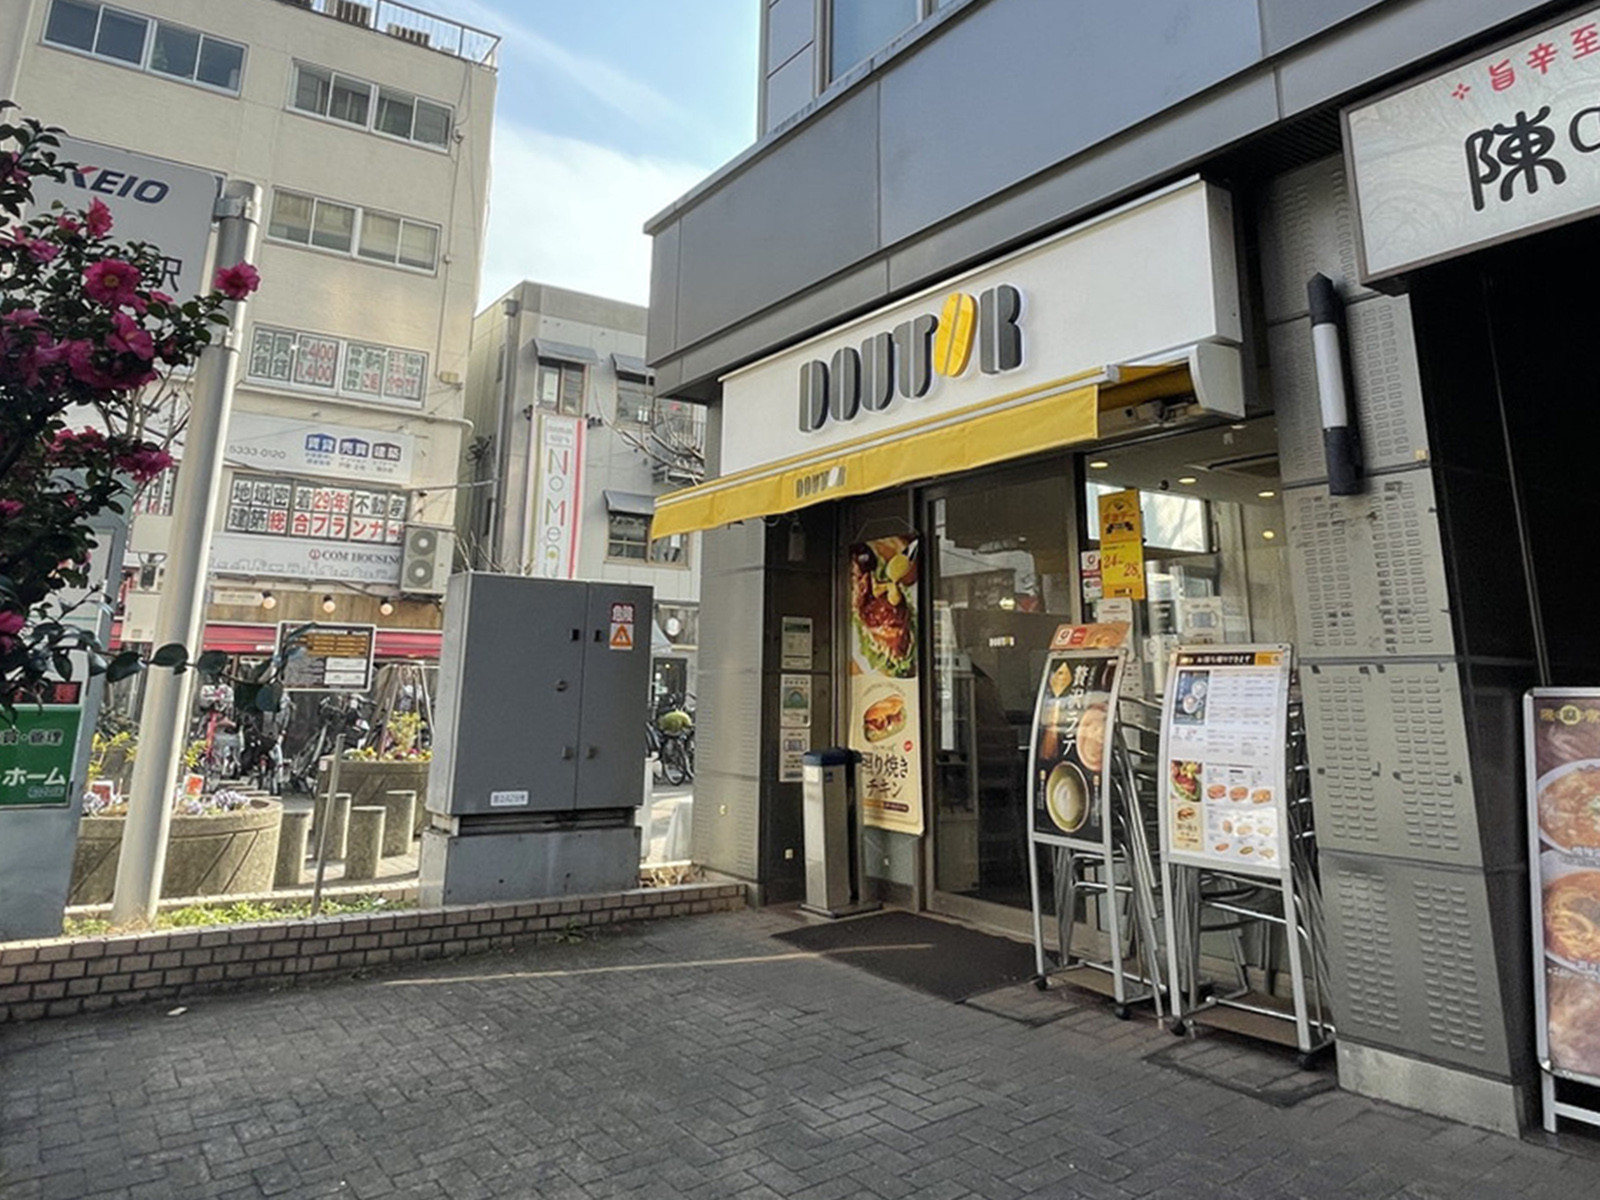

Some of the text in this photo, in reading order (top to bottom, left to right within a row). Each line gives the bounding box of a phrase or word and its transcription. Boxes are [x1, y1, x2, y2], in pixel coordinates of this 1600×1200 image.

[72, 165, 169, 204] KEIO
[798, 284, 1022, 433] DOUTOR
[322, 551, 349, 561] COM
